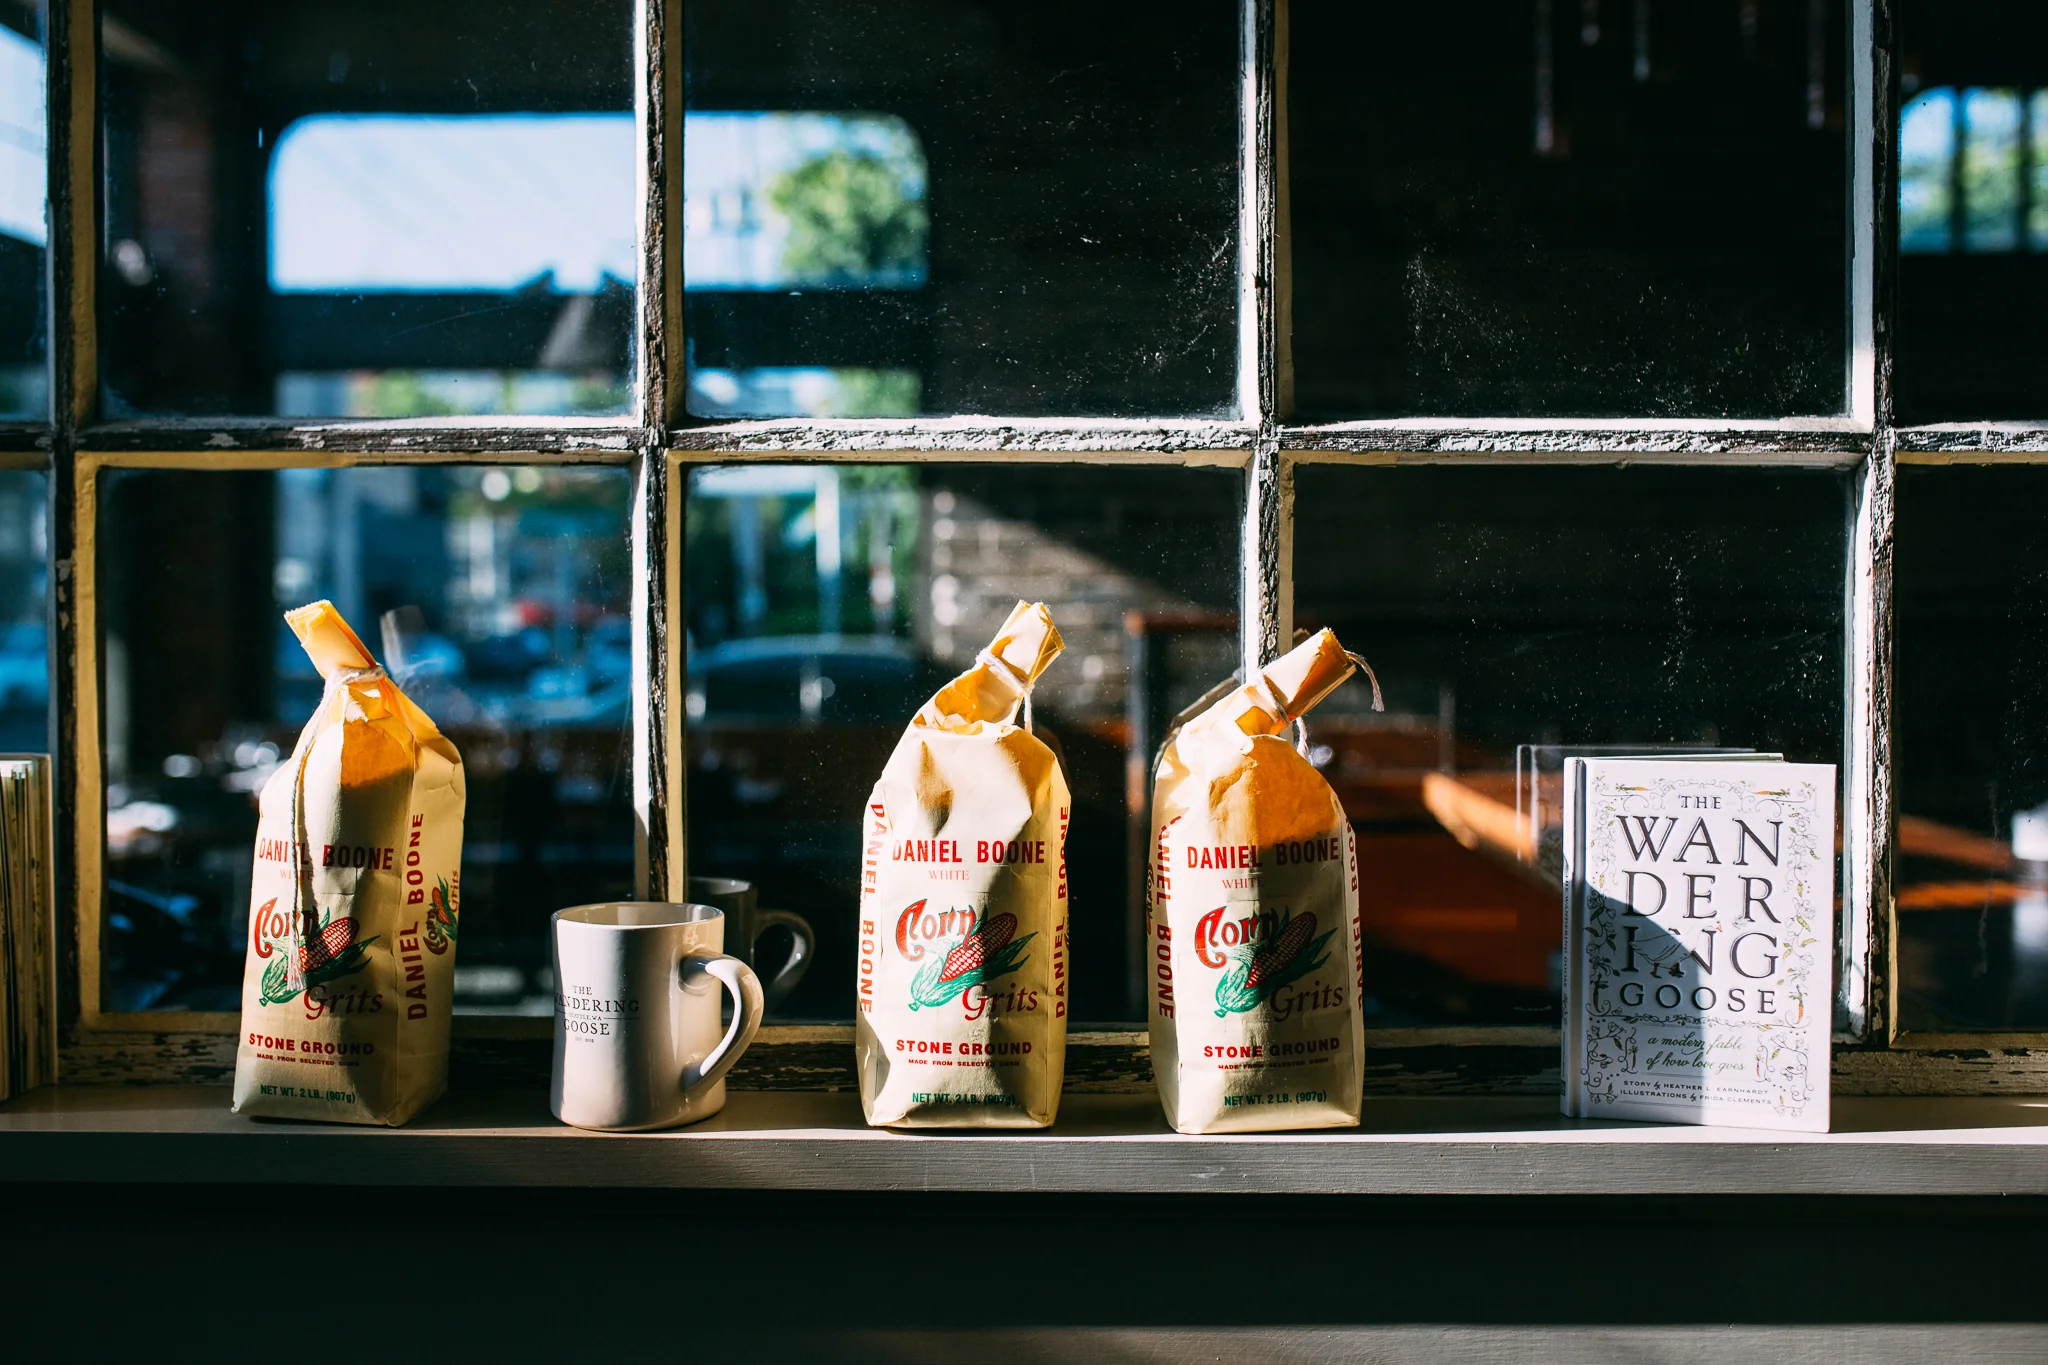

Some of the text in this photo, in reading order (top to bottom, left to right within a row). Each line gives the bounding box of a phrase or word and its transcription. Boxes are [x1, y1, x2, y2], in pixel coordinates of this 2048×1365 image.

[1680, 795, 1722, 809] THE
[893, 839, 1045, 864] DANIEL BOONE
[1187, 837, 1339, 869] DANIEL BOONE
[1615, 815, 1783, 867] WAN
[259, 838, 394, 870] DANIL BOONE
[928, 869, 970, 881] WHITE
[1222, 877, 1265, 890] WHITE
[449, 869, 460, 913] Grits
[1622, 870, 1781, 923] DER
[400, 813, 427, 1020] DANIEL BOONE
[860, 803, 888, 1013] DANIEL BOONE
[422, 908, 449, 955] Corn
[895, 898, 976, 962] Corn
[1195, 905, 1279, 969] Corn
[1621, 925, 1779, 979] ING
[1054, 916, 1065, 1019] DANIEL
[1157, 923, 1174, 1019] BOONE
[304, 985, 383, 1020] Grits
[572, 985, 592, 995] THE
[962, 983, 1038, 1021] Grits
[1270, 980, 1344, 1022] Grits
[1620, 982, 1776, 1014] GOOSE
[564, 1019, 609, 1035] GOOSE
[249, 1033, 374, 1055] STONE GROUND
[896, 1039, 1032, 1055] STONE GROUND
[1204, 1037, 1340, 1058] STONE GROUND
[1647, 1031, 1745, 1054] a modern fable
[300, 1058, 335, 1066] SELECTED
[1269, 1060, 1306, 1068] SELECTED
[1646, 1051, 1745, 1075] of how love goes
[260, 1085, 355, 1104] NET WT. 2 LB. (907g)
[912, 1093, 931, 1102] NET
[934, 1093, 953, 1104] WT.
[955, 1094, 961, 1103] 2
[964, 1094, 980, 1104] LB.
[1224, 1090, 1327, 1106] NET WT. 2 LB. (907g)
[1620, 1090, 1687, 1099] ILLUSTRATIONS
[1689, 1093, 1697, 1102] by
[1728, 1097, 1772, 1105] CLEMENTS
[1653, 1081, 1661, 1090] by
[1664, 1083, 1703, 1091] HEATHER
[1717, 1087, 1768, 1095] EARNHARDT
